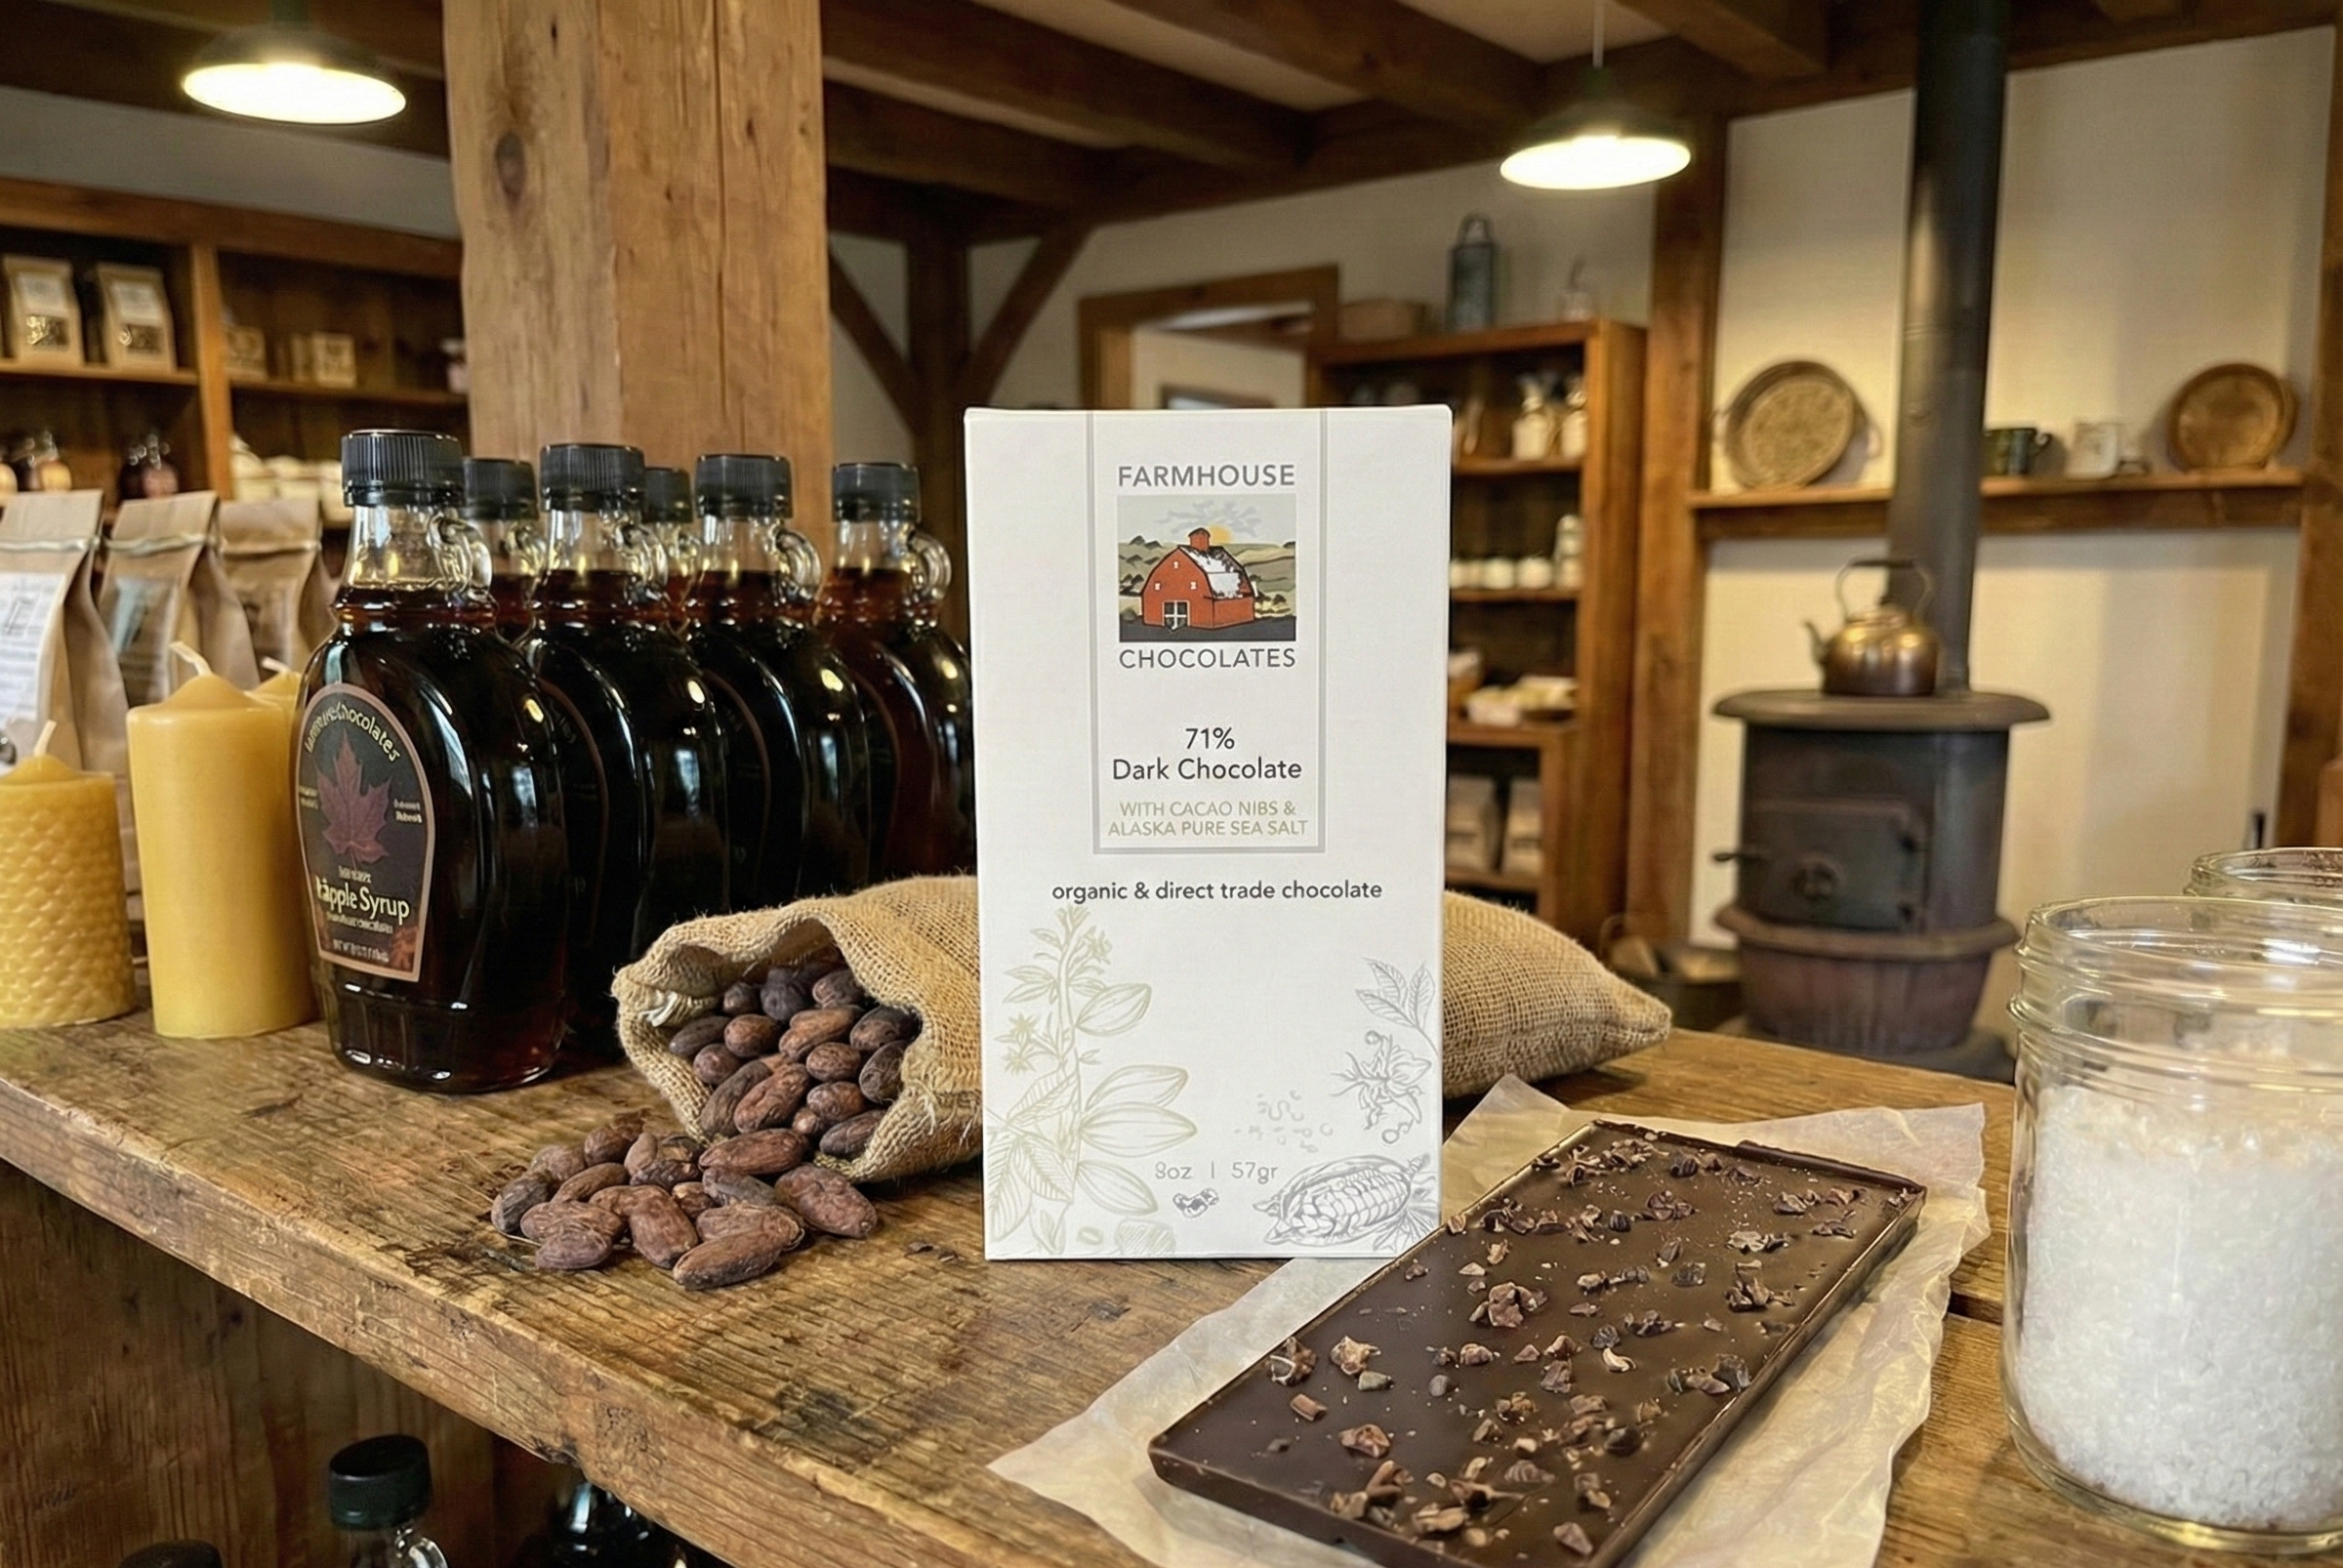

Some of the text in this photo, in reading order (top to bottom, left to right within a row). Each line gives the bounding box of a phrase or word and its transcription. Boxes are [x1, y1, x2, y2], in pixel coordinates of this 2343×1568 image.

[1118, 464, 1295, 487] FARMHOUSE
[1119, 647, 1295, 669] CHOCOLATES
[1184, 726, 1236, 750] 71%
[1112, 756, 1302, 780] Dark Chocolate
[1120, 800, 1296, 817] WITH CACAO NIBS &
[1108, 819, 1308, 837] ALASKA PURE SEA SALT
[1051, 879, 1383, 904] organic & direct trade chocolate
[359, 886, 410, 926] Syrup
[1230, 1161, 1279, 1185] 57gr
